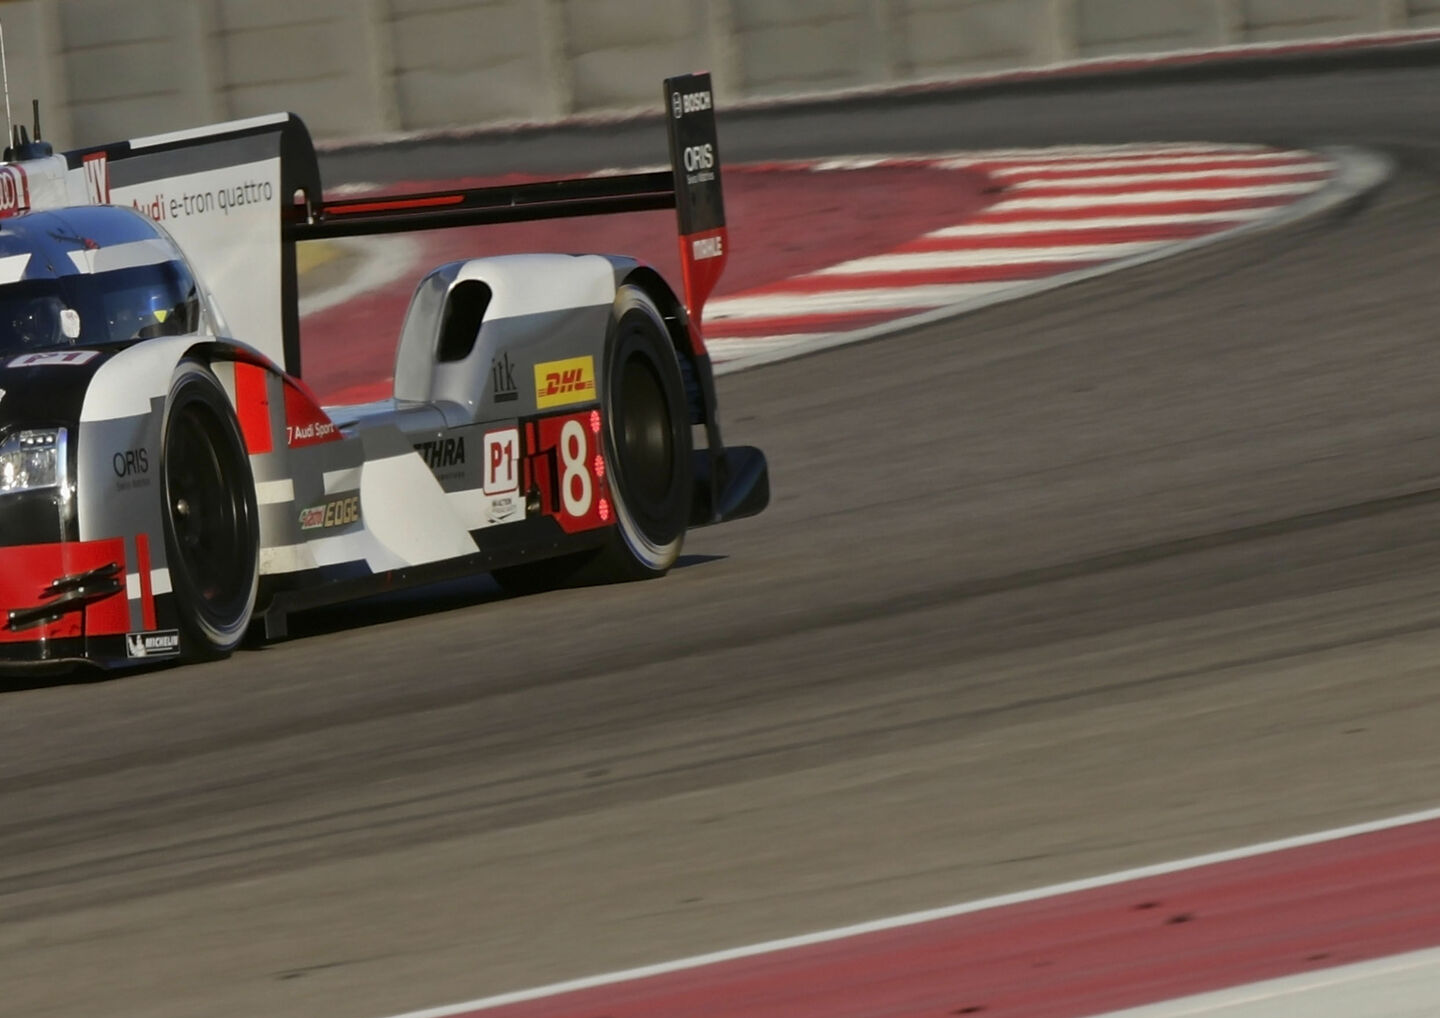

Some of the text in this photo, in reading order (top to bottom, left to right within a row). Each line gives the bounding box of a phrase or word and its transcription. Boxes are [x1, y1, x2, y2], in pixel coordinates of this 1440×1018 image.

[683, 91, 711, 113] BOSCH
[684, 144, 713, 171] ORIS
[170, 192, 214, 218] e-tron
[217, 180, 273, 215] quattro
[492, 352, 517, 392] itk
[545, 368, 586, 395] DHL
[295, 422, 334, 439] Audi Sport
[113, 448, 148, 477] ORIS
[491, 440, 512, 483] P1
[561, 420, 592, 517] 8
[324, 497, 358, 527] EDGE
